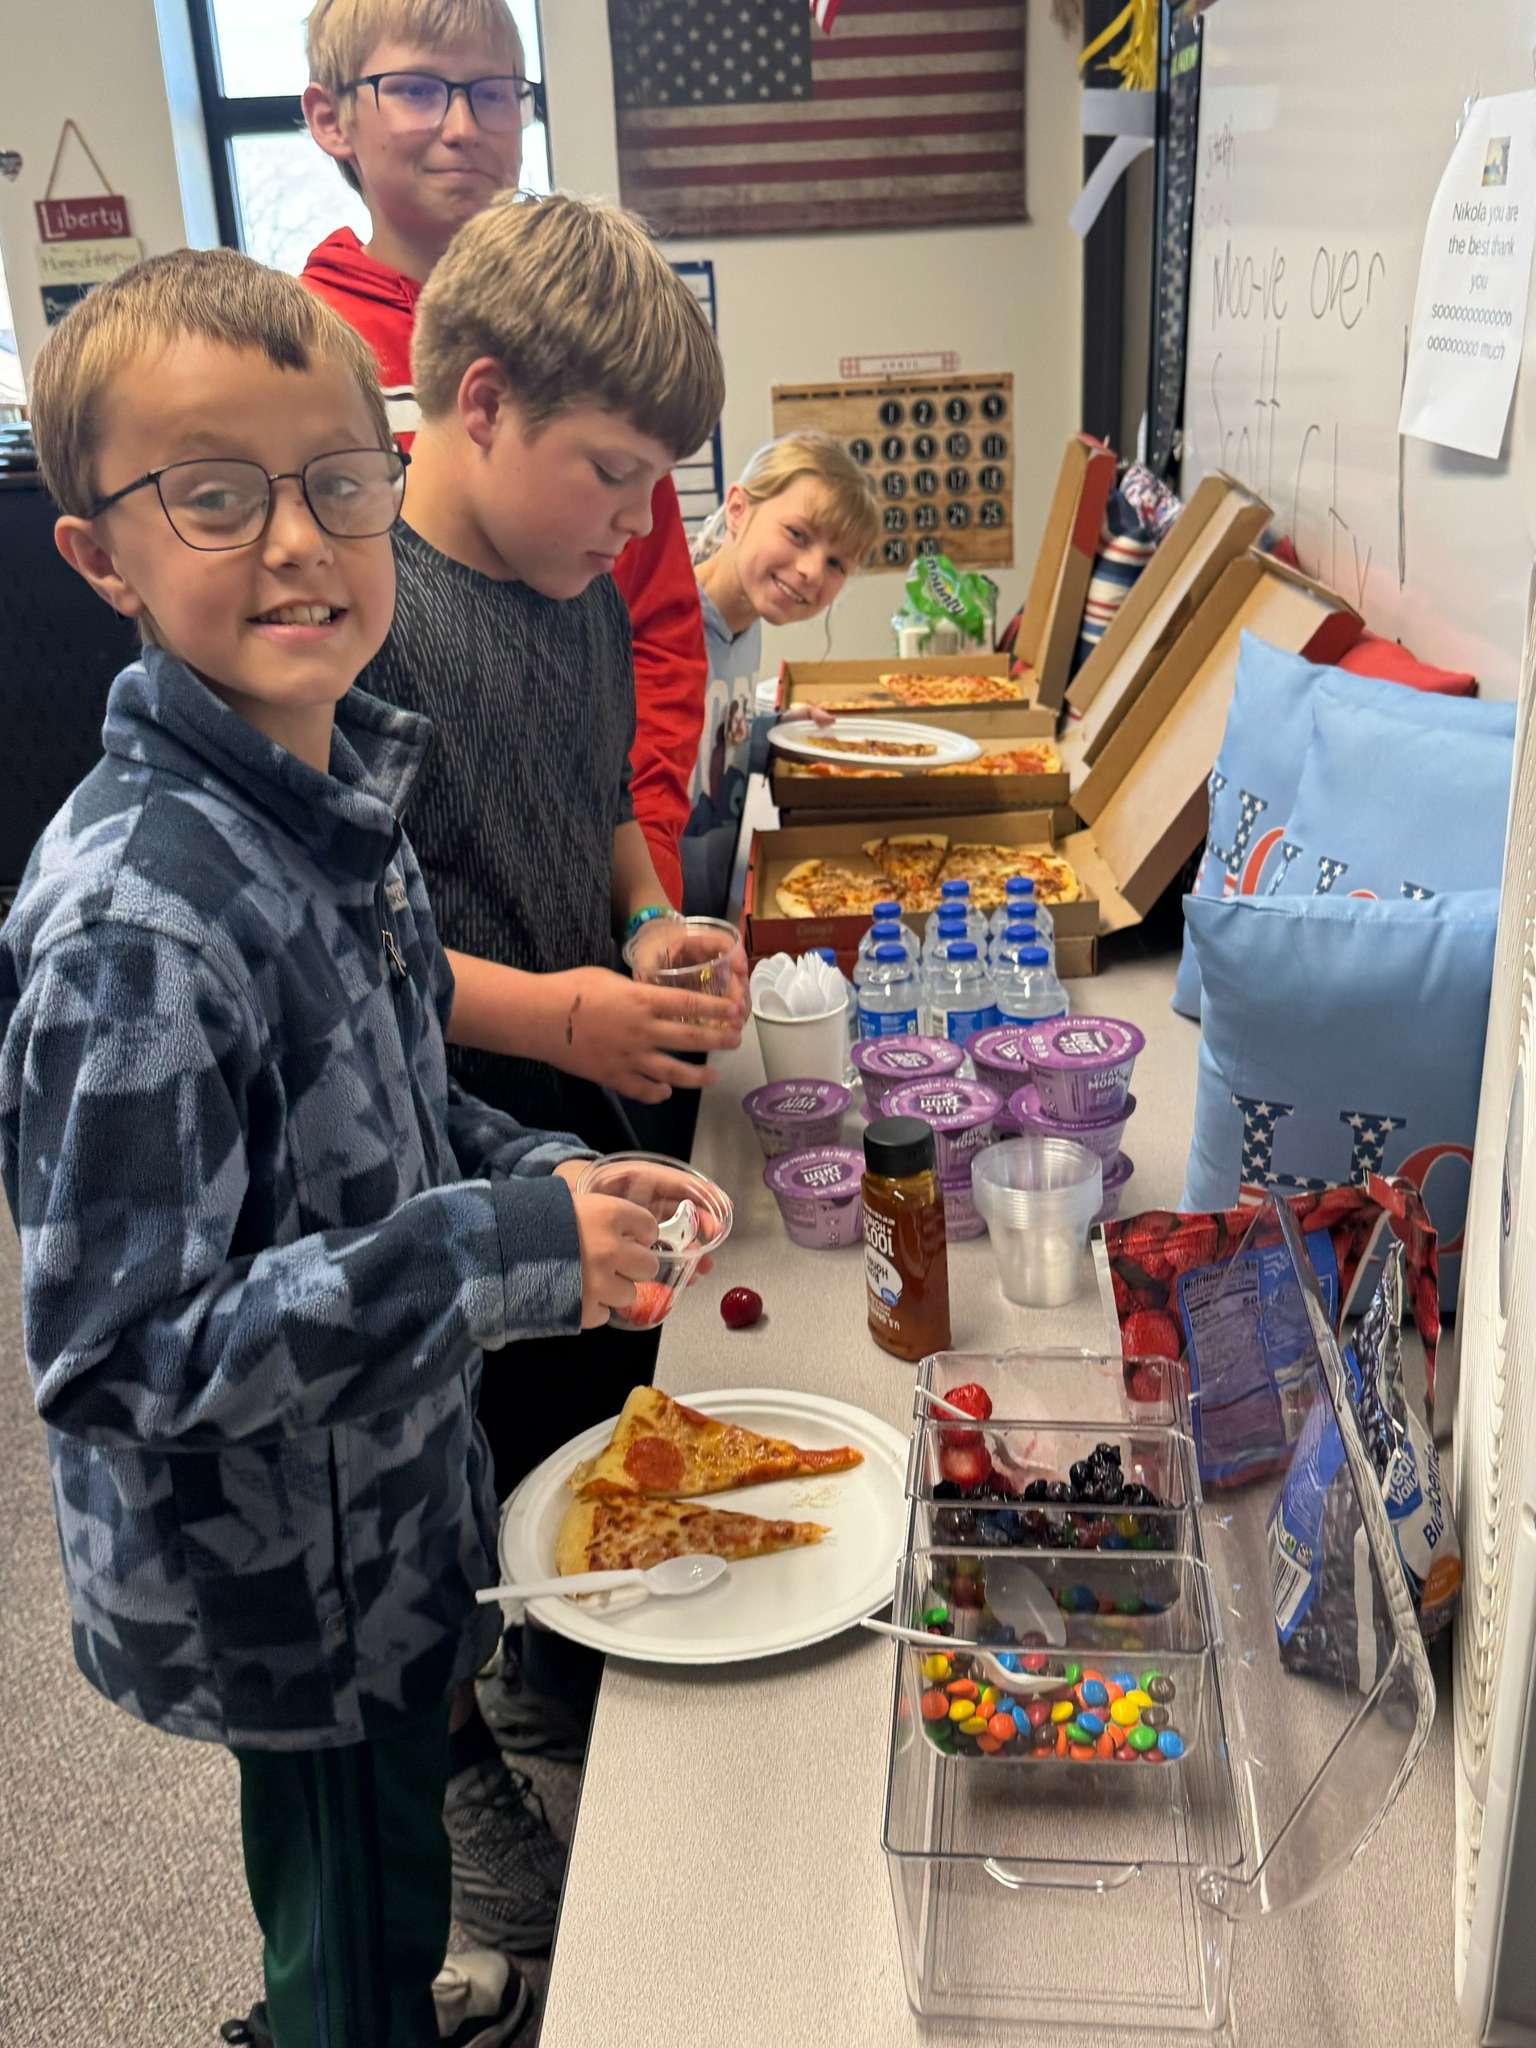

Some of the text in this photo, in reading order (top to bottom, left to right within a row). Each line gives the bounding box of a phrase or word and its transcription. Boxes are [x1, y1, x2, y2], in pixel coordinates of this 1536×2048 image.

[40, 203, 124, 239] Liberty
[1452, 202, 1519, 227] Nikola you are
[1448, 235, 1515, 256] the best thank
[1469, 273, 1489, 294] you
[1481, 340, 1505, 361] much
